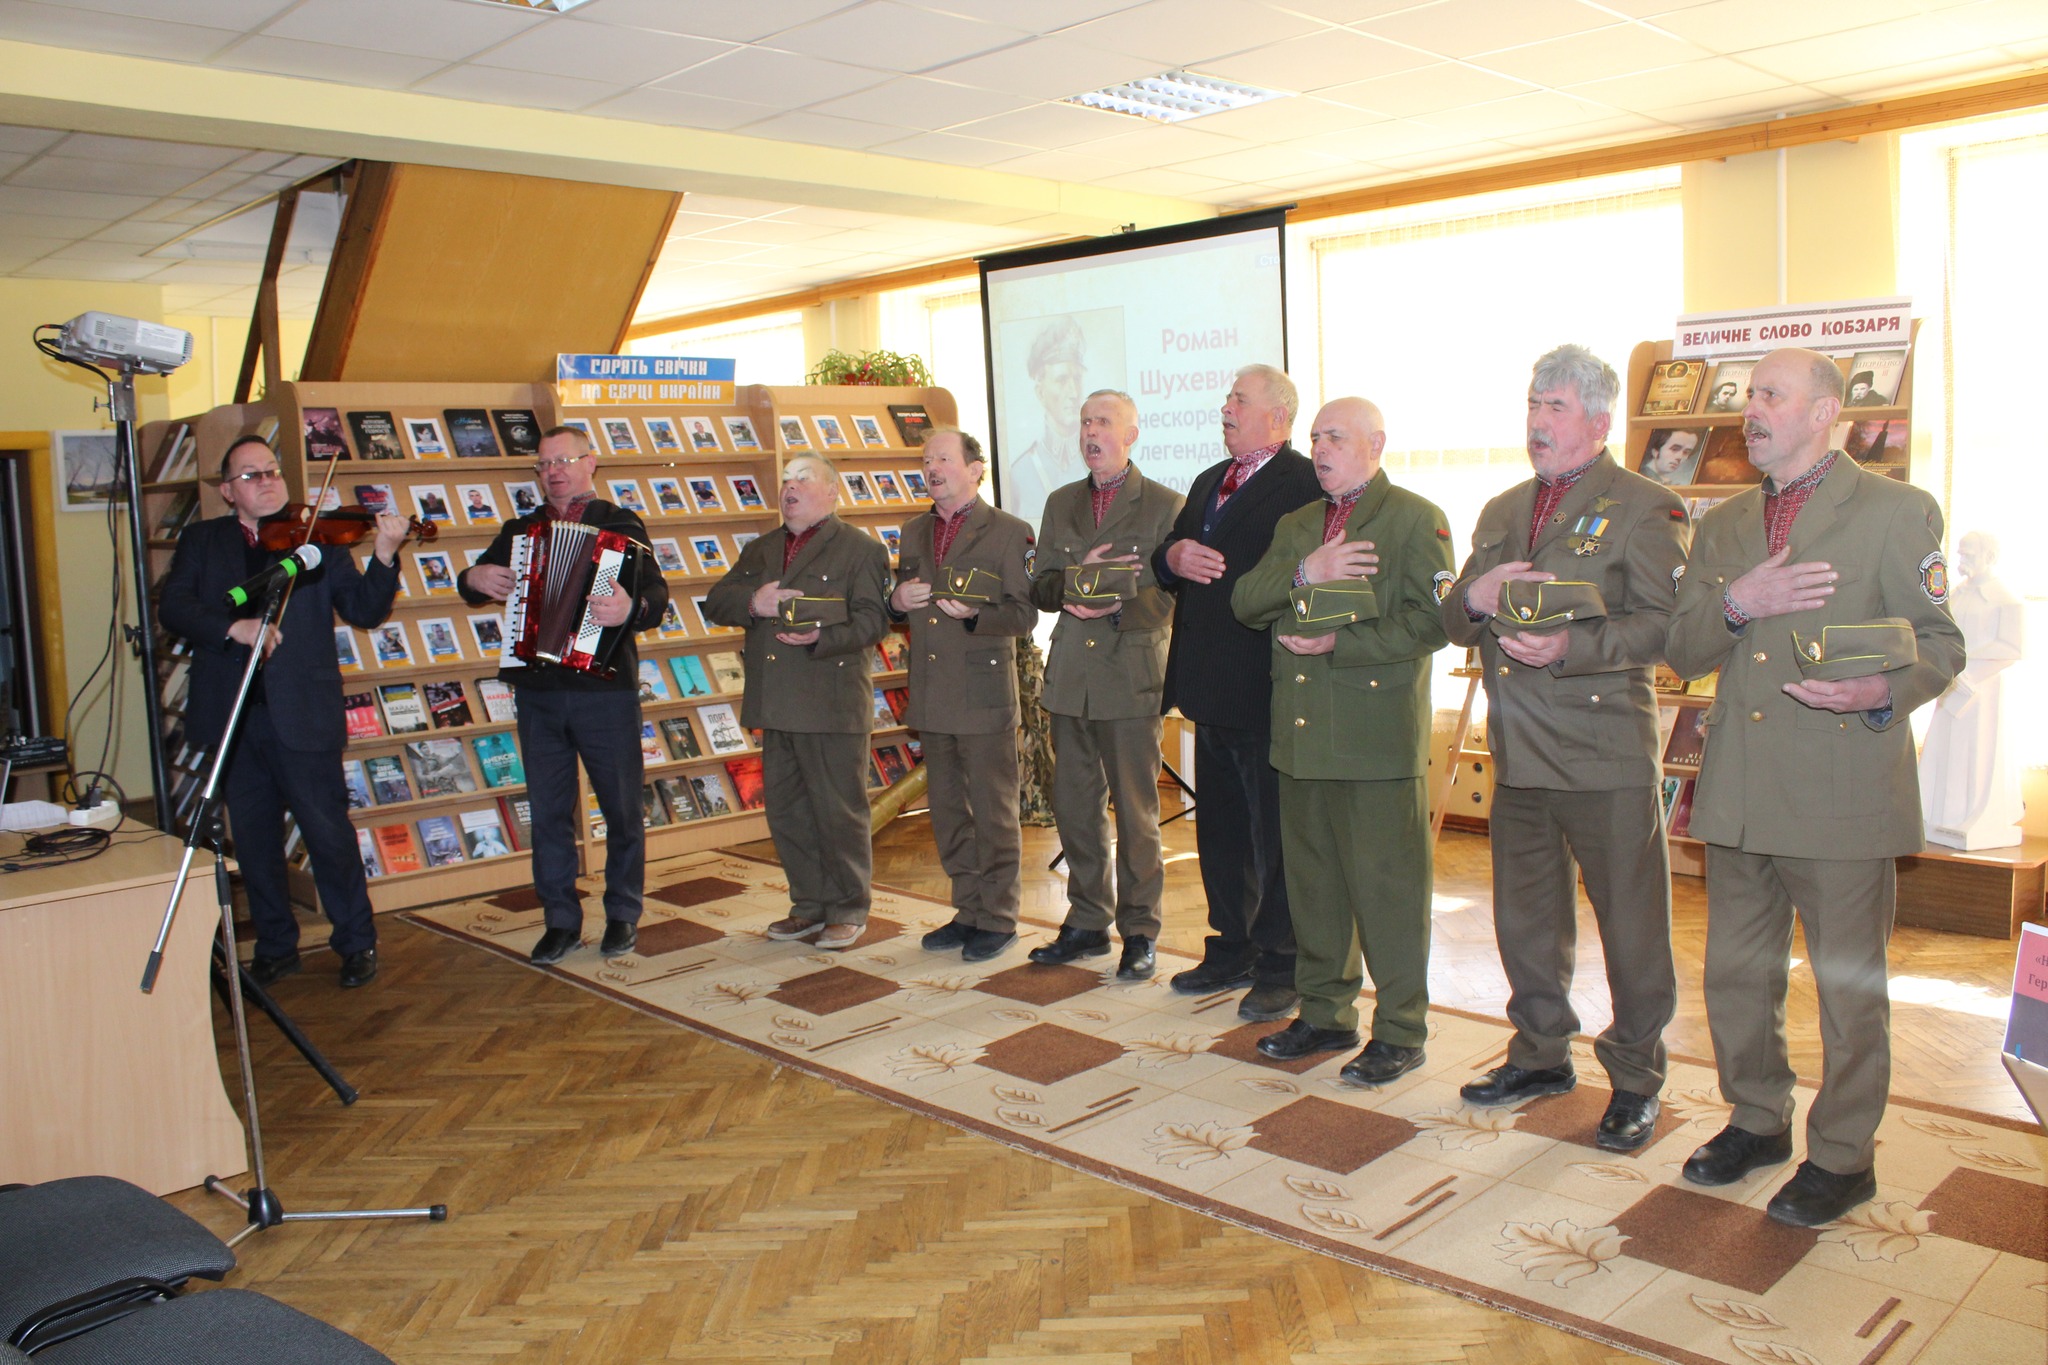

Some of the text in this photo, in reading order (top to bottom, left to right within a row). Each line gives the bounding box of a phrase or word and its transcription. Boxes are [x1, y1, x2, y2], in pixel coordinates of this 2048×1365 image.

[1260, 255, 1280, 266] Сто
[1682, 316, 1900, 346] ВЕЛИЧНЕ СЛОВО КОБЗАРЯ
[1162, 327, 1239, 354] Роман
[590, 358, 708, 376] ГОРЯТЬ СВІЧКИ
[581, 382, 721, 400] НА СЕРЦІ УКРАЇНИ
[1140, 368, 1235, 400] Шухеви
[1138, 408, 1222, 431] нескоре
[1157, 476, 1194, 493] ком
[2035, 955, 2048, 967] «Н
[2029, 973, 2048, 991] Гер
